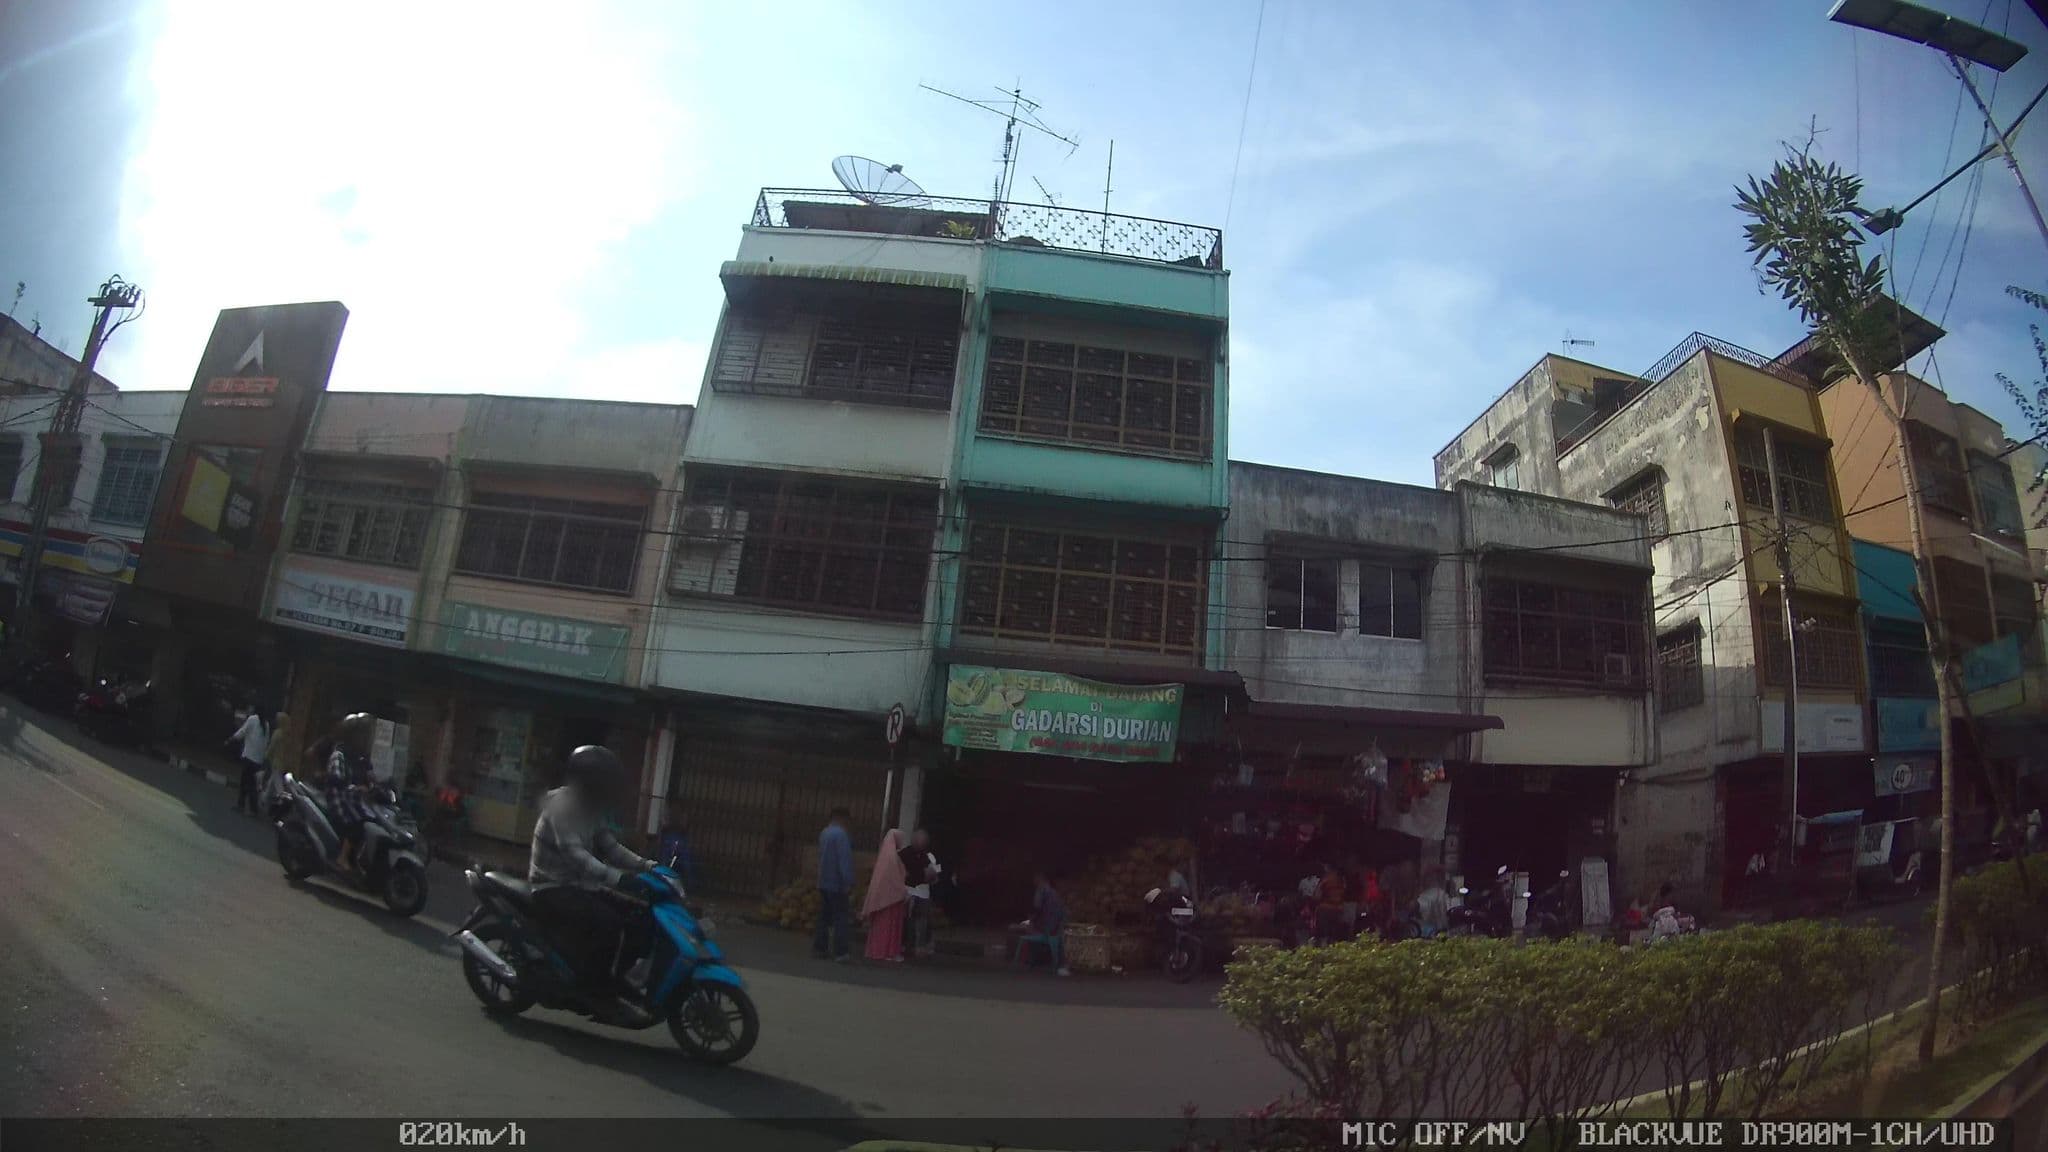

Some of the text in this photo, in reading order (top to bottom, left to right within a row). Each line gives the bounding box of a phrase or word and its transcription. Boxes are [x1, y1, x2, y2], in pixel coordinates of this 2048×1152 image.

[464, 610, 593, 657] ANGGREK
[1090, 702, 1103, 713] DI
[1011, 708, 1098, 737] GADARSI
[1103, 717, 1173, 743] DURIAN
